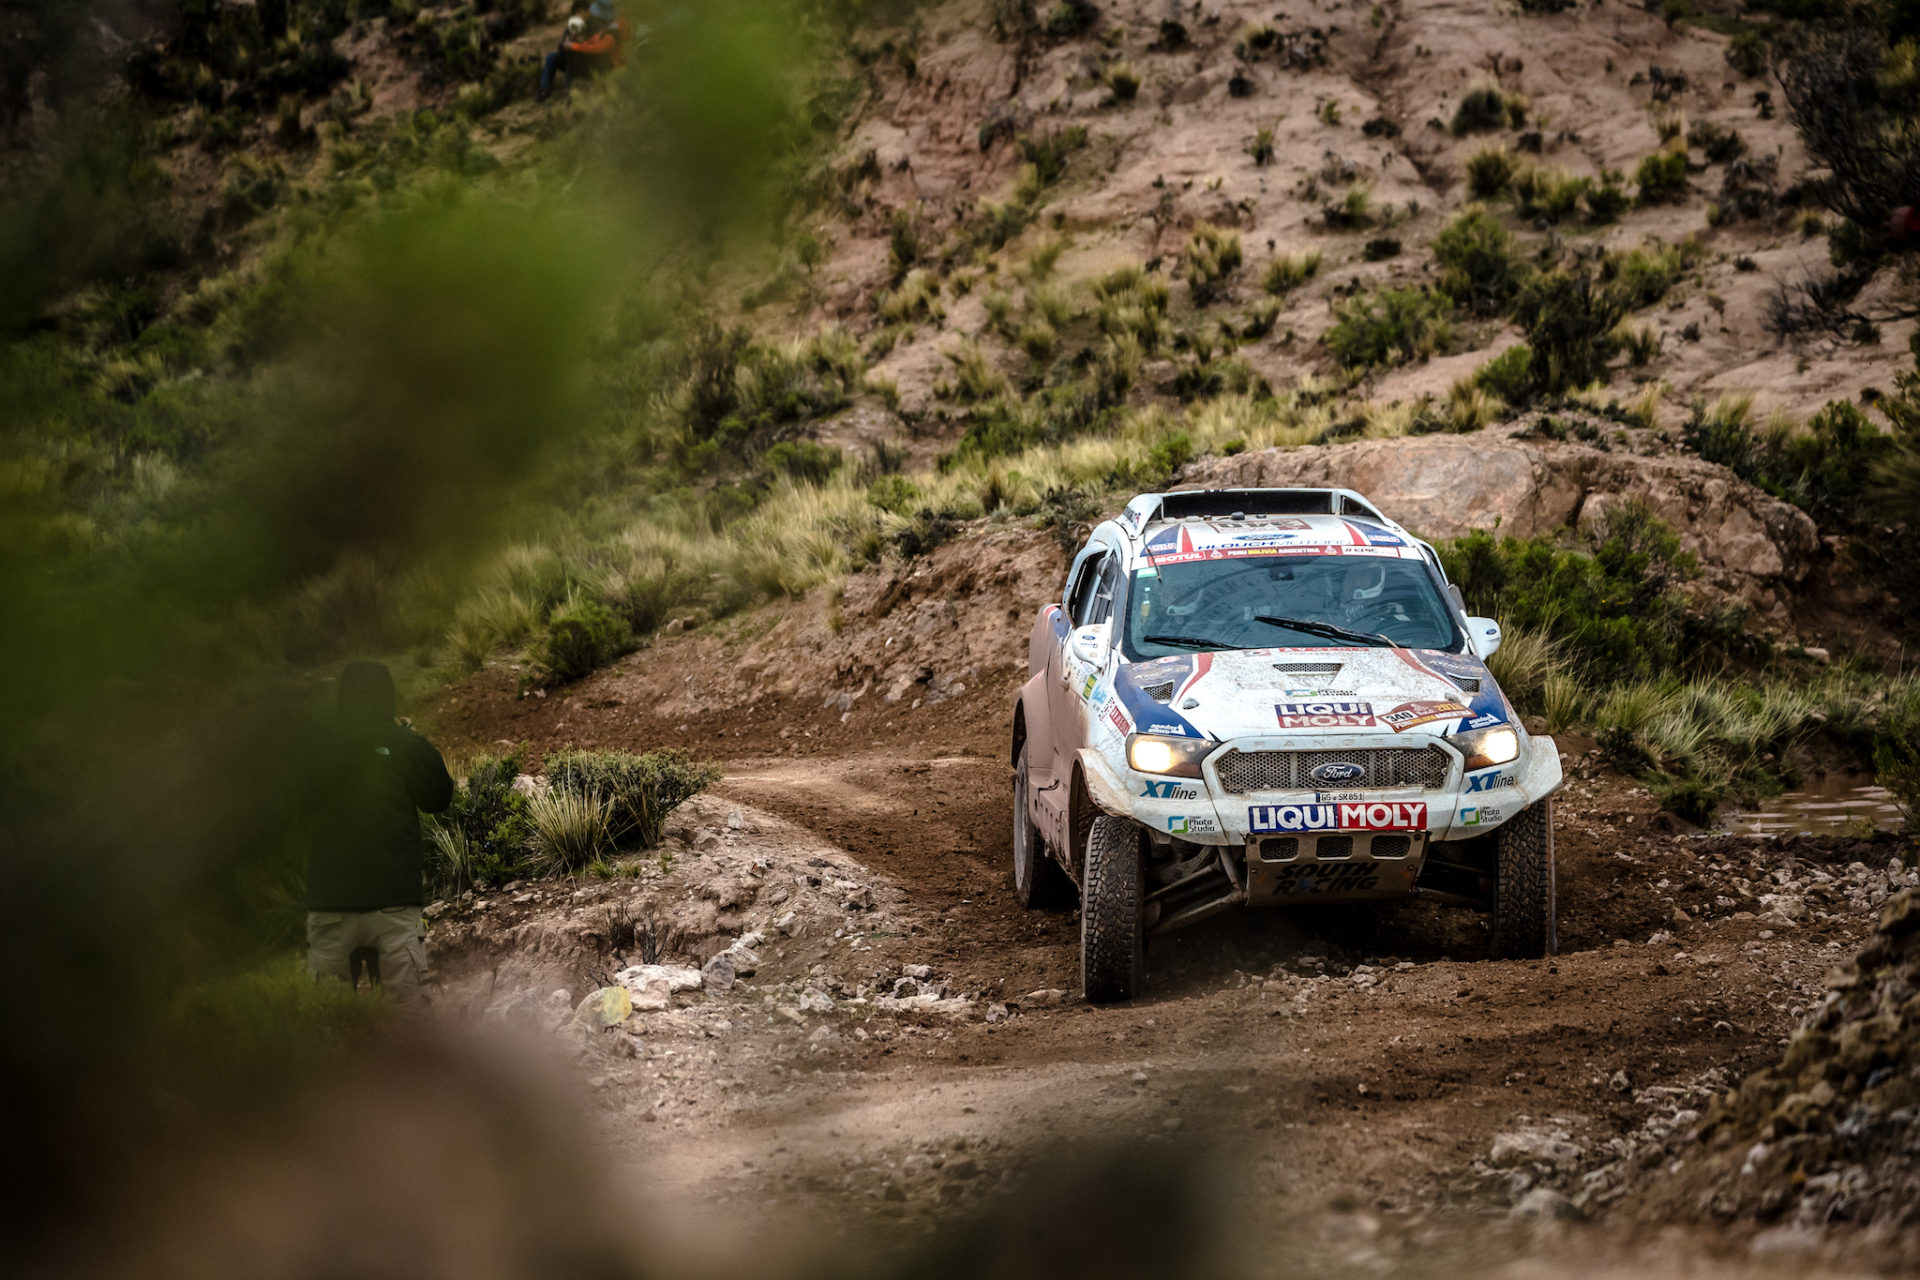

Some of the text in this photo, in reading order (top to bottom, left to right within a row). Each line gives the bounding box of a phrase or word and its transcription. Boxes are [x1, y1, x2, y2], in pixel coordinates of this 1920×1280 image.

[1154, 552, 1203, 564] MOTUL
[1280, 703, 1371, 716] LIQUI
[1282, 715, 1373, 728] MOLY
[1386, 713, 1413, 723] 340
[1323, 765, 1353, 779] Ford
[1464, 770, 1514, 794] XTline
[1139, 780, 1197, 800] XTline
[1252, 803, 1425, 830] LIQUI MOLY
[1189, 825, 1215, 833] Studio
[1276, 862, 1380, 880] SOUTH
